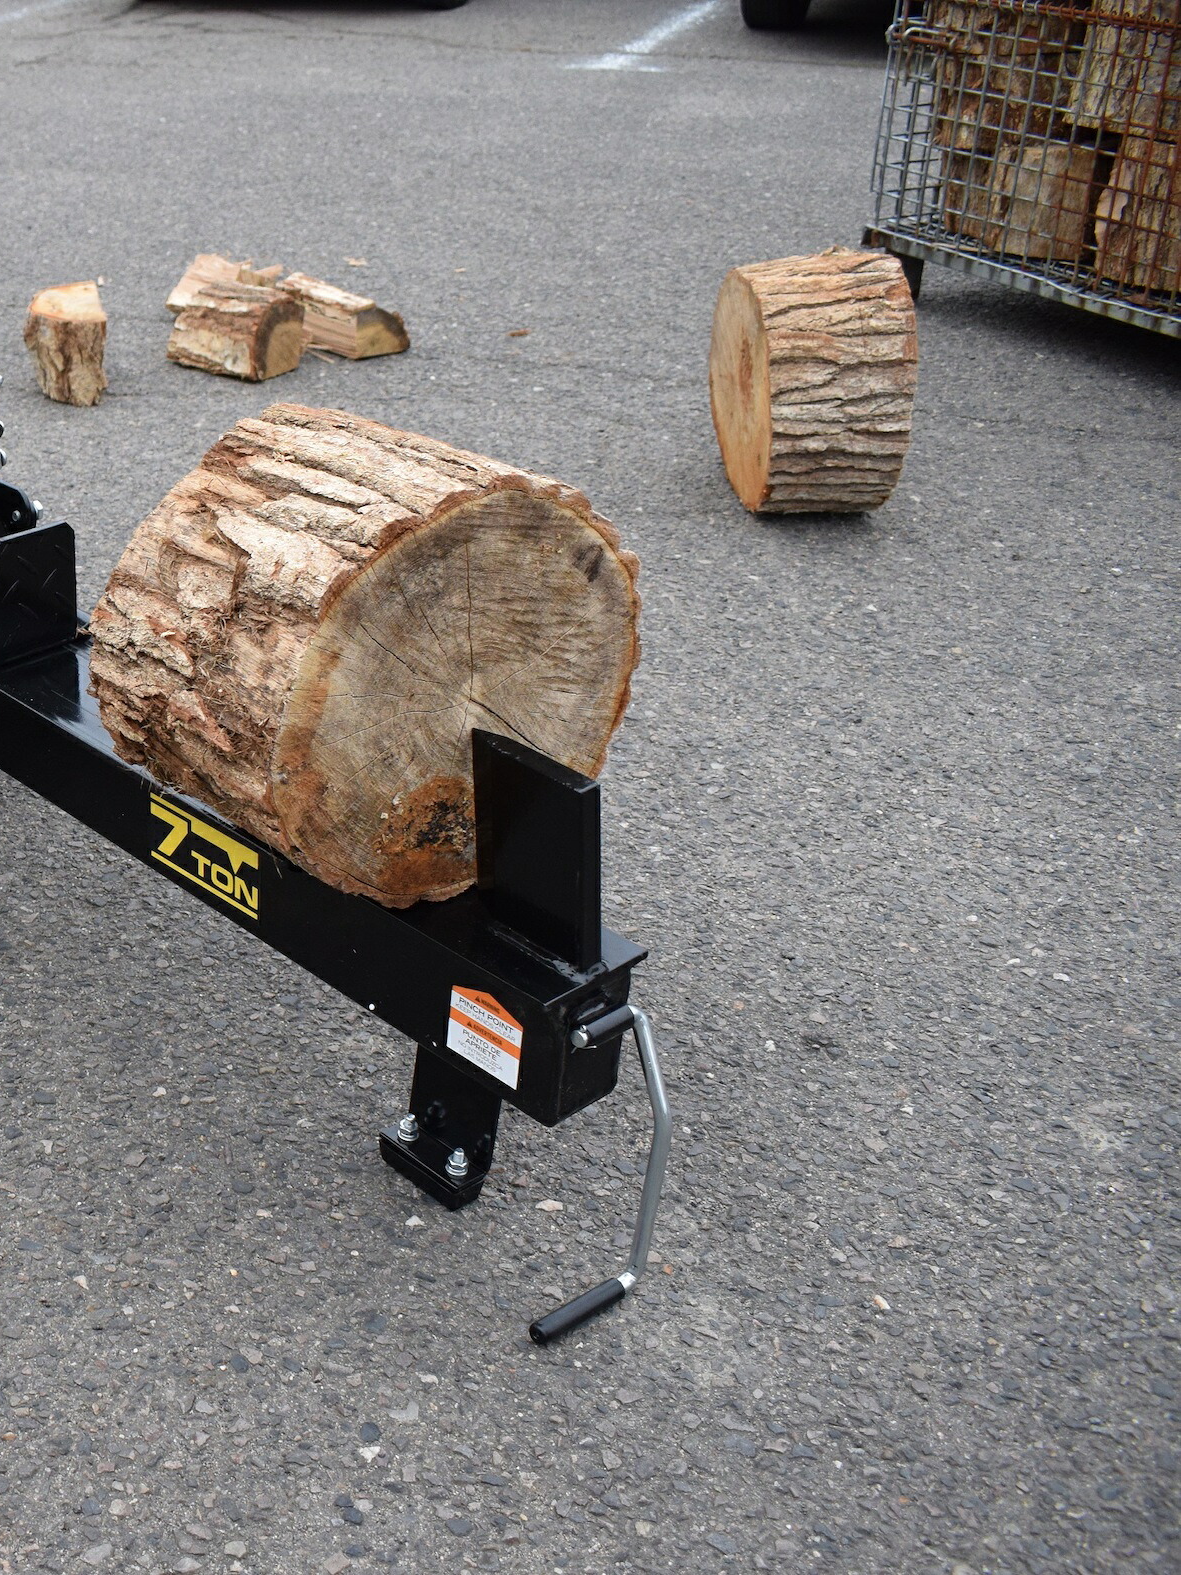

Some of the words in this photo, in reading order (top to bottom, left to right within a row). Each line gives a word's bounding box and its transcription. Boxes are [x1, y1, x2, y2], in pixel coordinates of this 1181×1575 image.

[150, 801, 188, 857] 7
[191, 850, 258, 910] TON
[459, 996, 485, 1017] PINCH
[487, 1015, 514, 1034] POINT
[462, 1028, 489, 1049] PUNTO
[490, 1046, 502, 1058] DE
[494, 1026, 516, 1042] CLEAR
[465, 1038, 497, 1061] APRIETE
